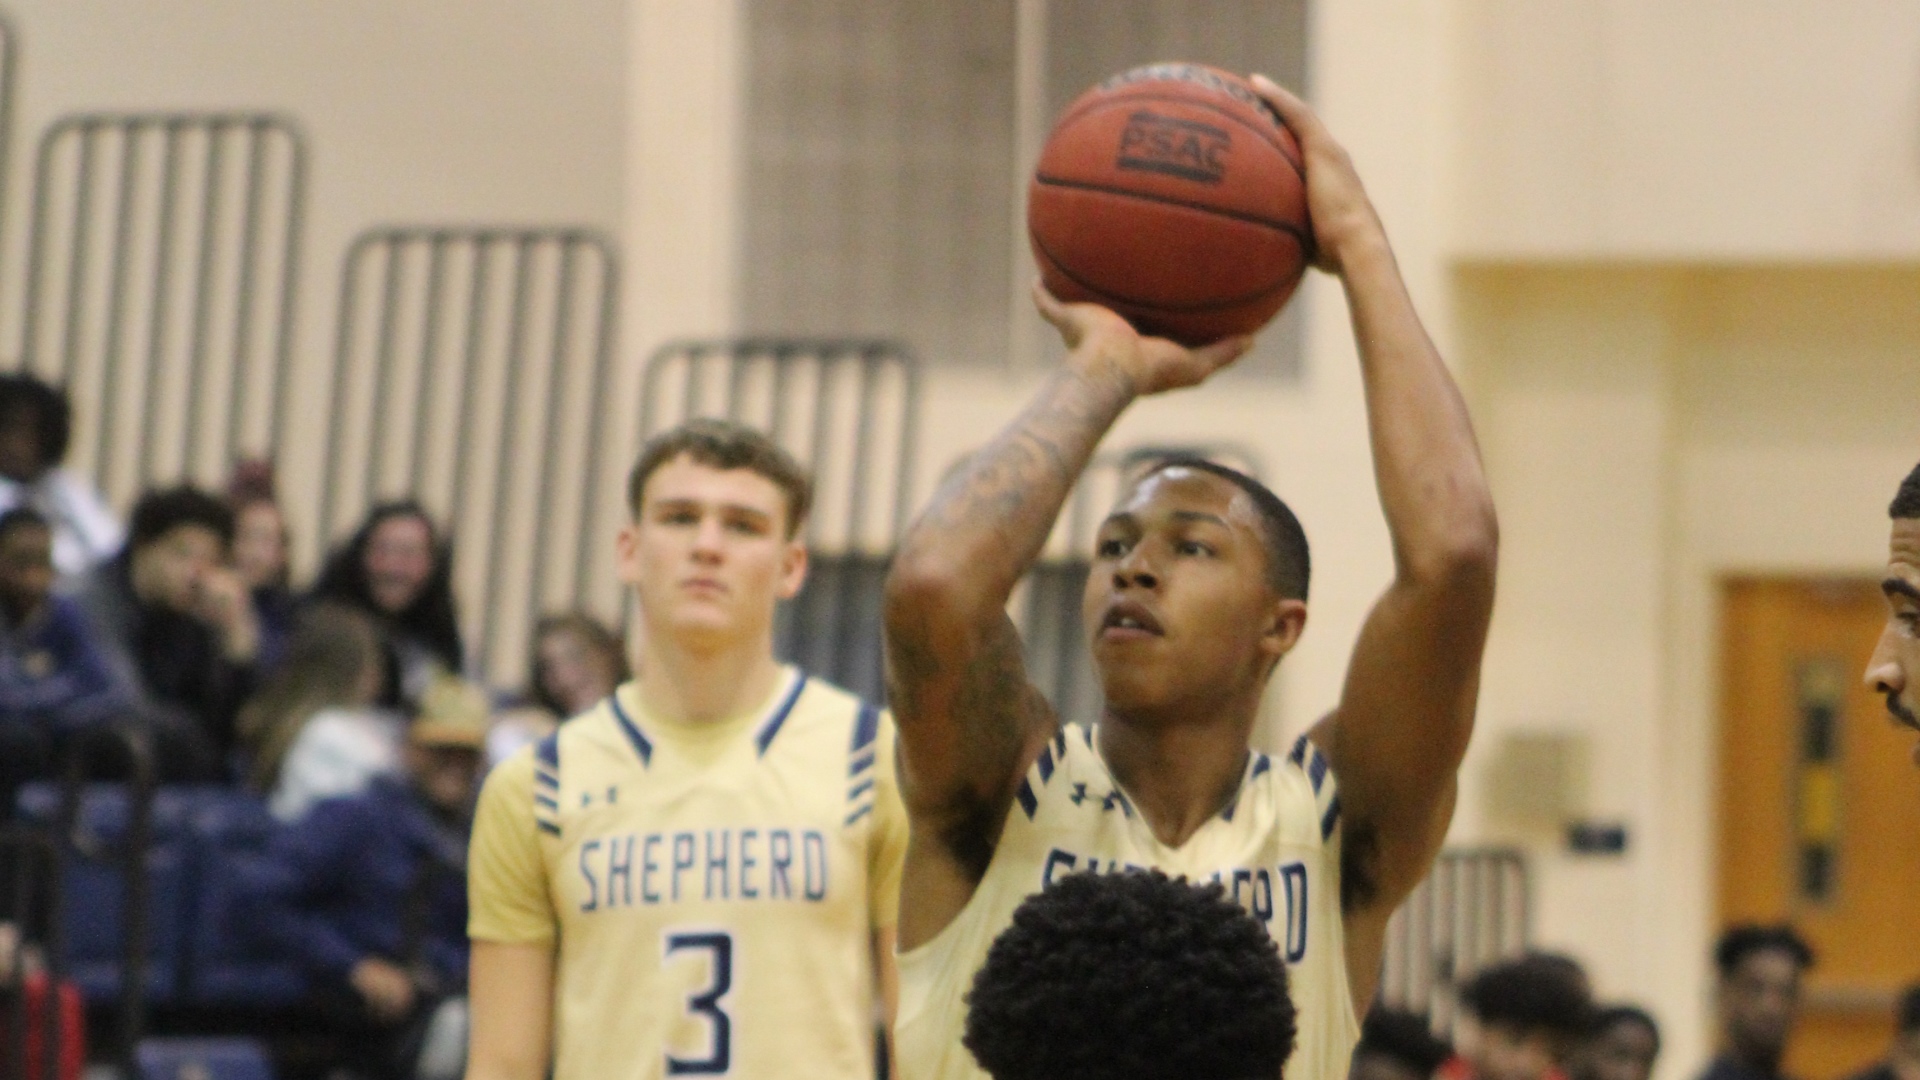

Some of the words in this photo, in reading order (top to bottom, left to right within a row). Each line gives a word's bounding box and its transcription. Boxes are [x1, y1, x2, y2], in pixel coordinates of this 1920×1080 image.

[1118, 123, 1231, 176] PSAC
[579, 828, 828, 913] SHEPHERD
[665, 932, 732, 1076] 3
